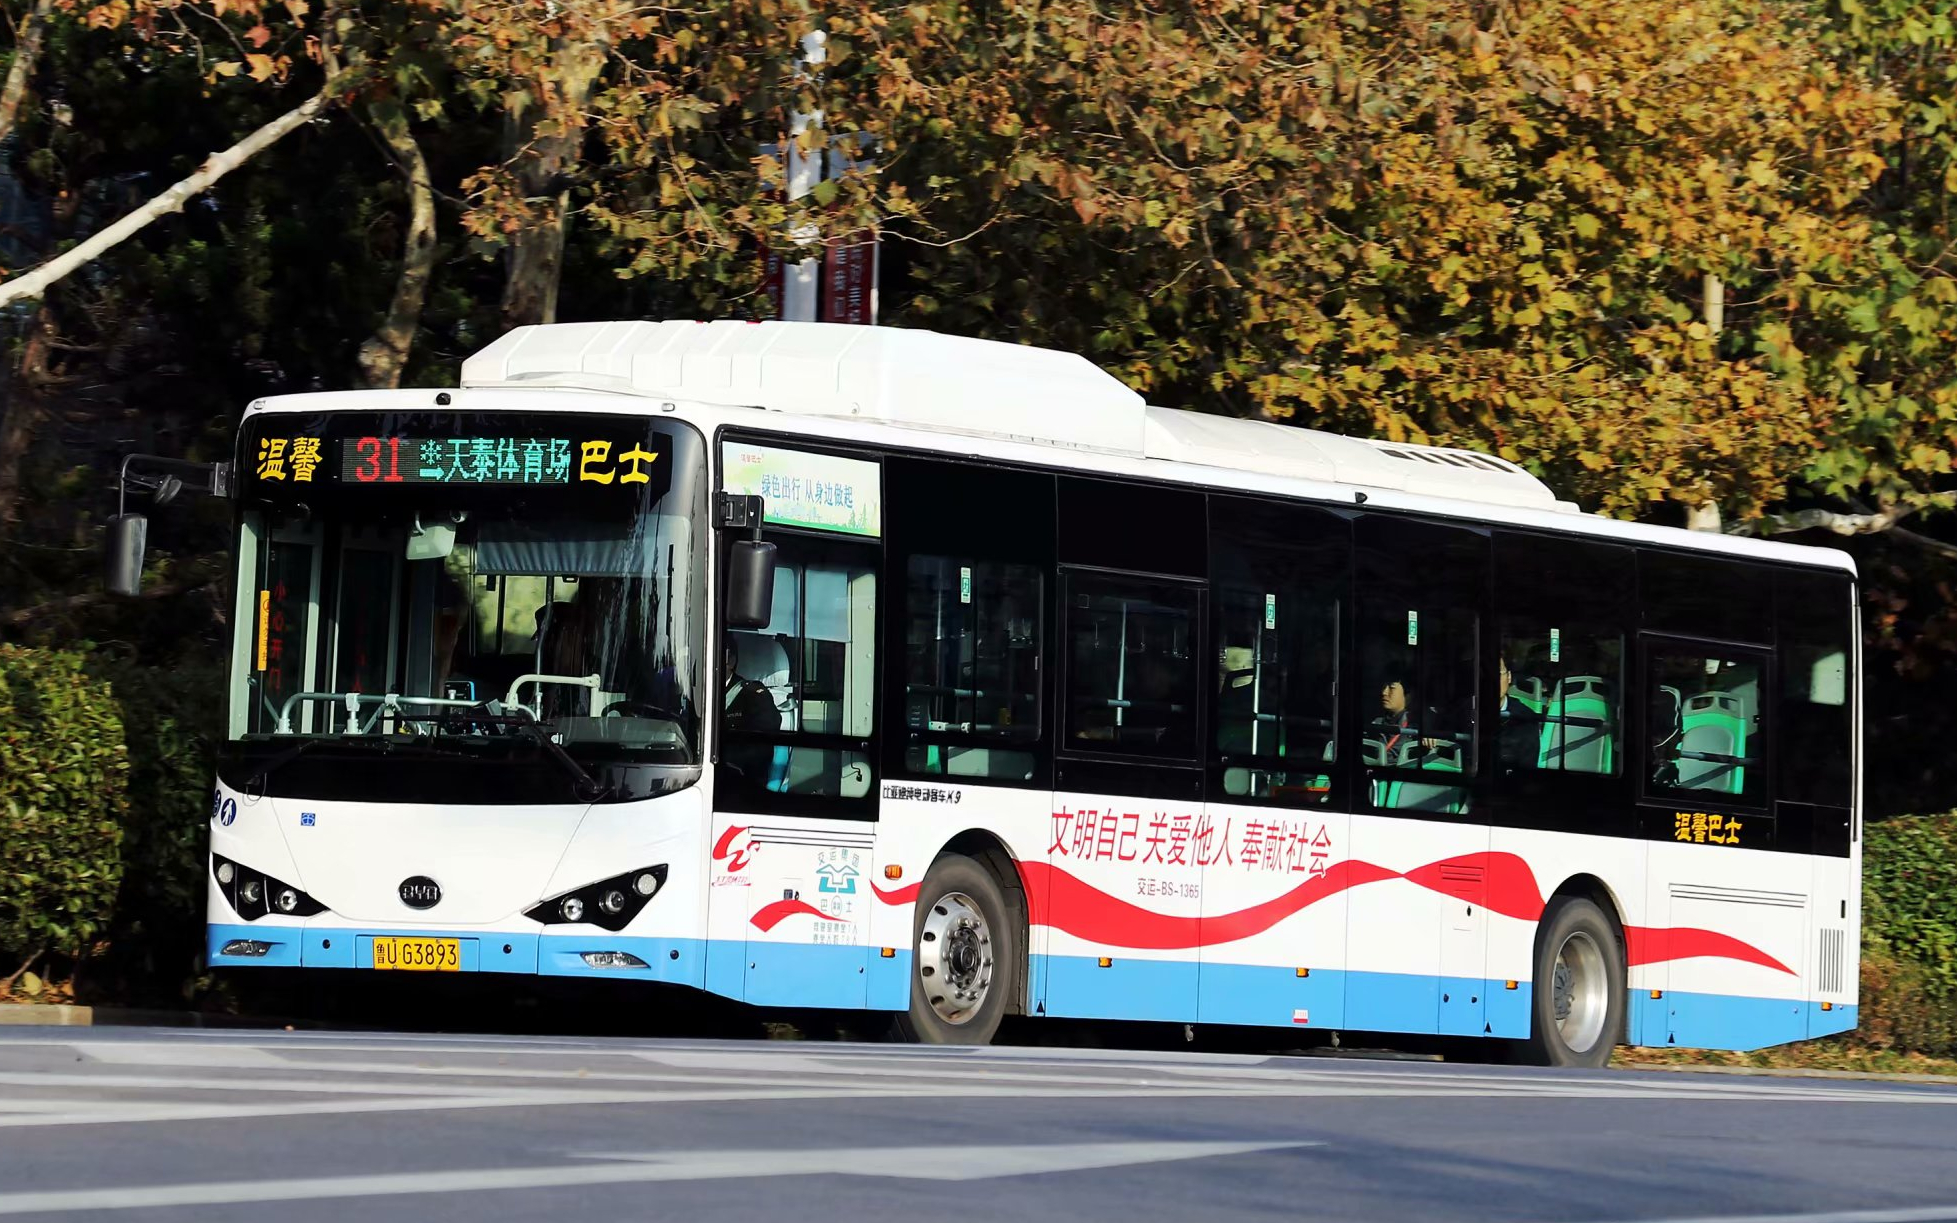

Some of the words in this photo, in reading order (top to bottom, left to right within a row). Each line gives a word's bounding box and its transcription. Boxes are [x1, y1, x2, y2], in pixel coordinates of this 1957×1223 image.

[256, 436, 323, 482] 温馨
[356, 436, 404, 483] 31
[444, 437, 572, 484] 天泰体育场
[580, 440, 659, 485] 巴士
[761, 473, 801, 506] 绿色出行
[805, 478, 853, 509] 从身边做起
[1047, 805, 1140, 862] 文明自己
[1142, 812, 1234, 867] 关爱他人
[1240, 818, 1332, 878] 奉献社会
[1674, 812, 1743, 844] 温馨巴士
[1137, 877, 1200, 899] 交运-BS-1365
